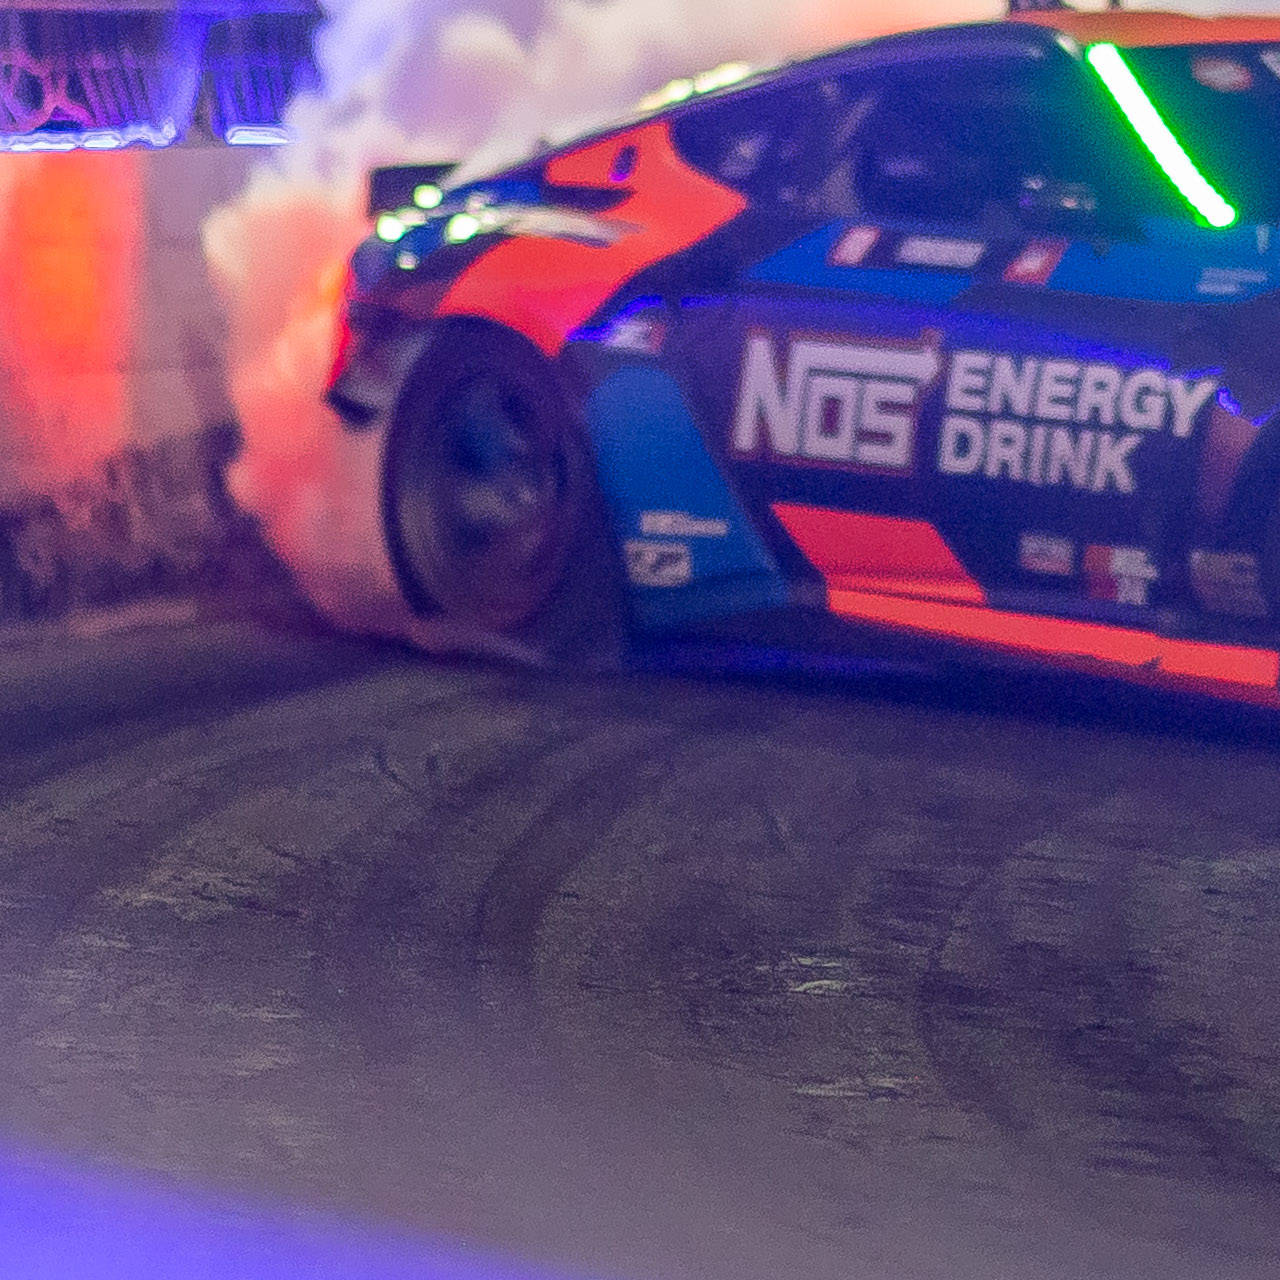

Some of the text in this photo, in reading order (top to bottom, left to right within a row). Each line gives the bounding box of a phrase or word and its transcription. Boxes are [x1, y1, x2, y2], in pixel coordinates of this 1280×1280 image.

[732, 332, 940, 468] NOS
[946, 350, 1217, 439] ENERGY
[937, 416, 1143, 493] DRINK
